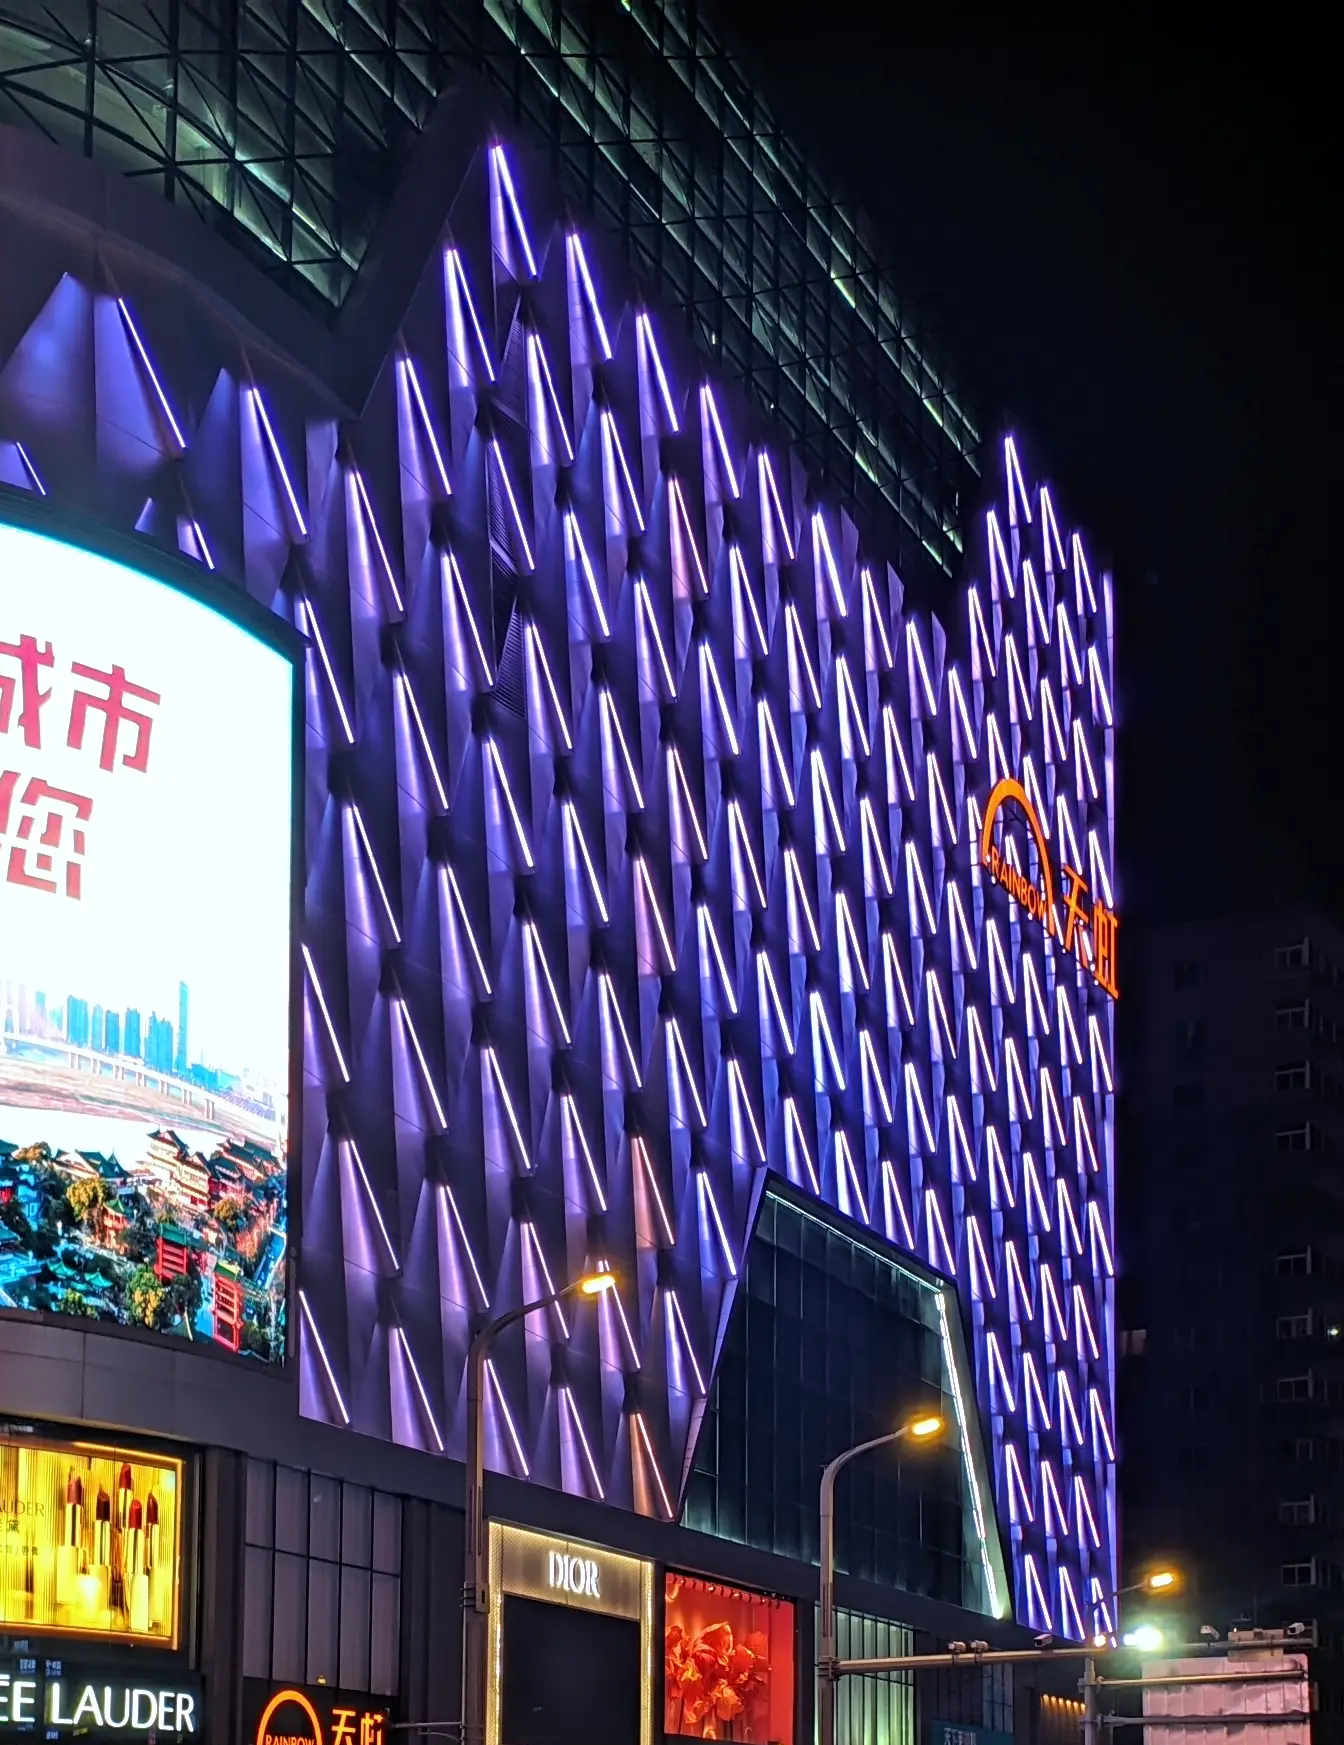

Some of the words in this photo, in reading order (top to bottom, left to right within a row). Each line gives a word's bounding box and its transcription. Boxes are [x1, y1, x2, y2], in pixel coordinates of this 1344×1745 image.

[990, 844, 1049, 922] RAINBOW
[1060, 862, 1120, 1001] 天虹
[548, 1549, 602, 1600] DIOR
[51, 1680, 196, 1733] LAUDER
